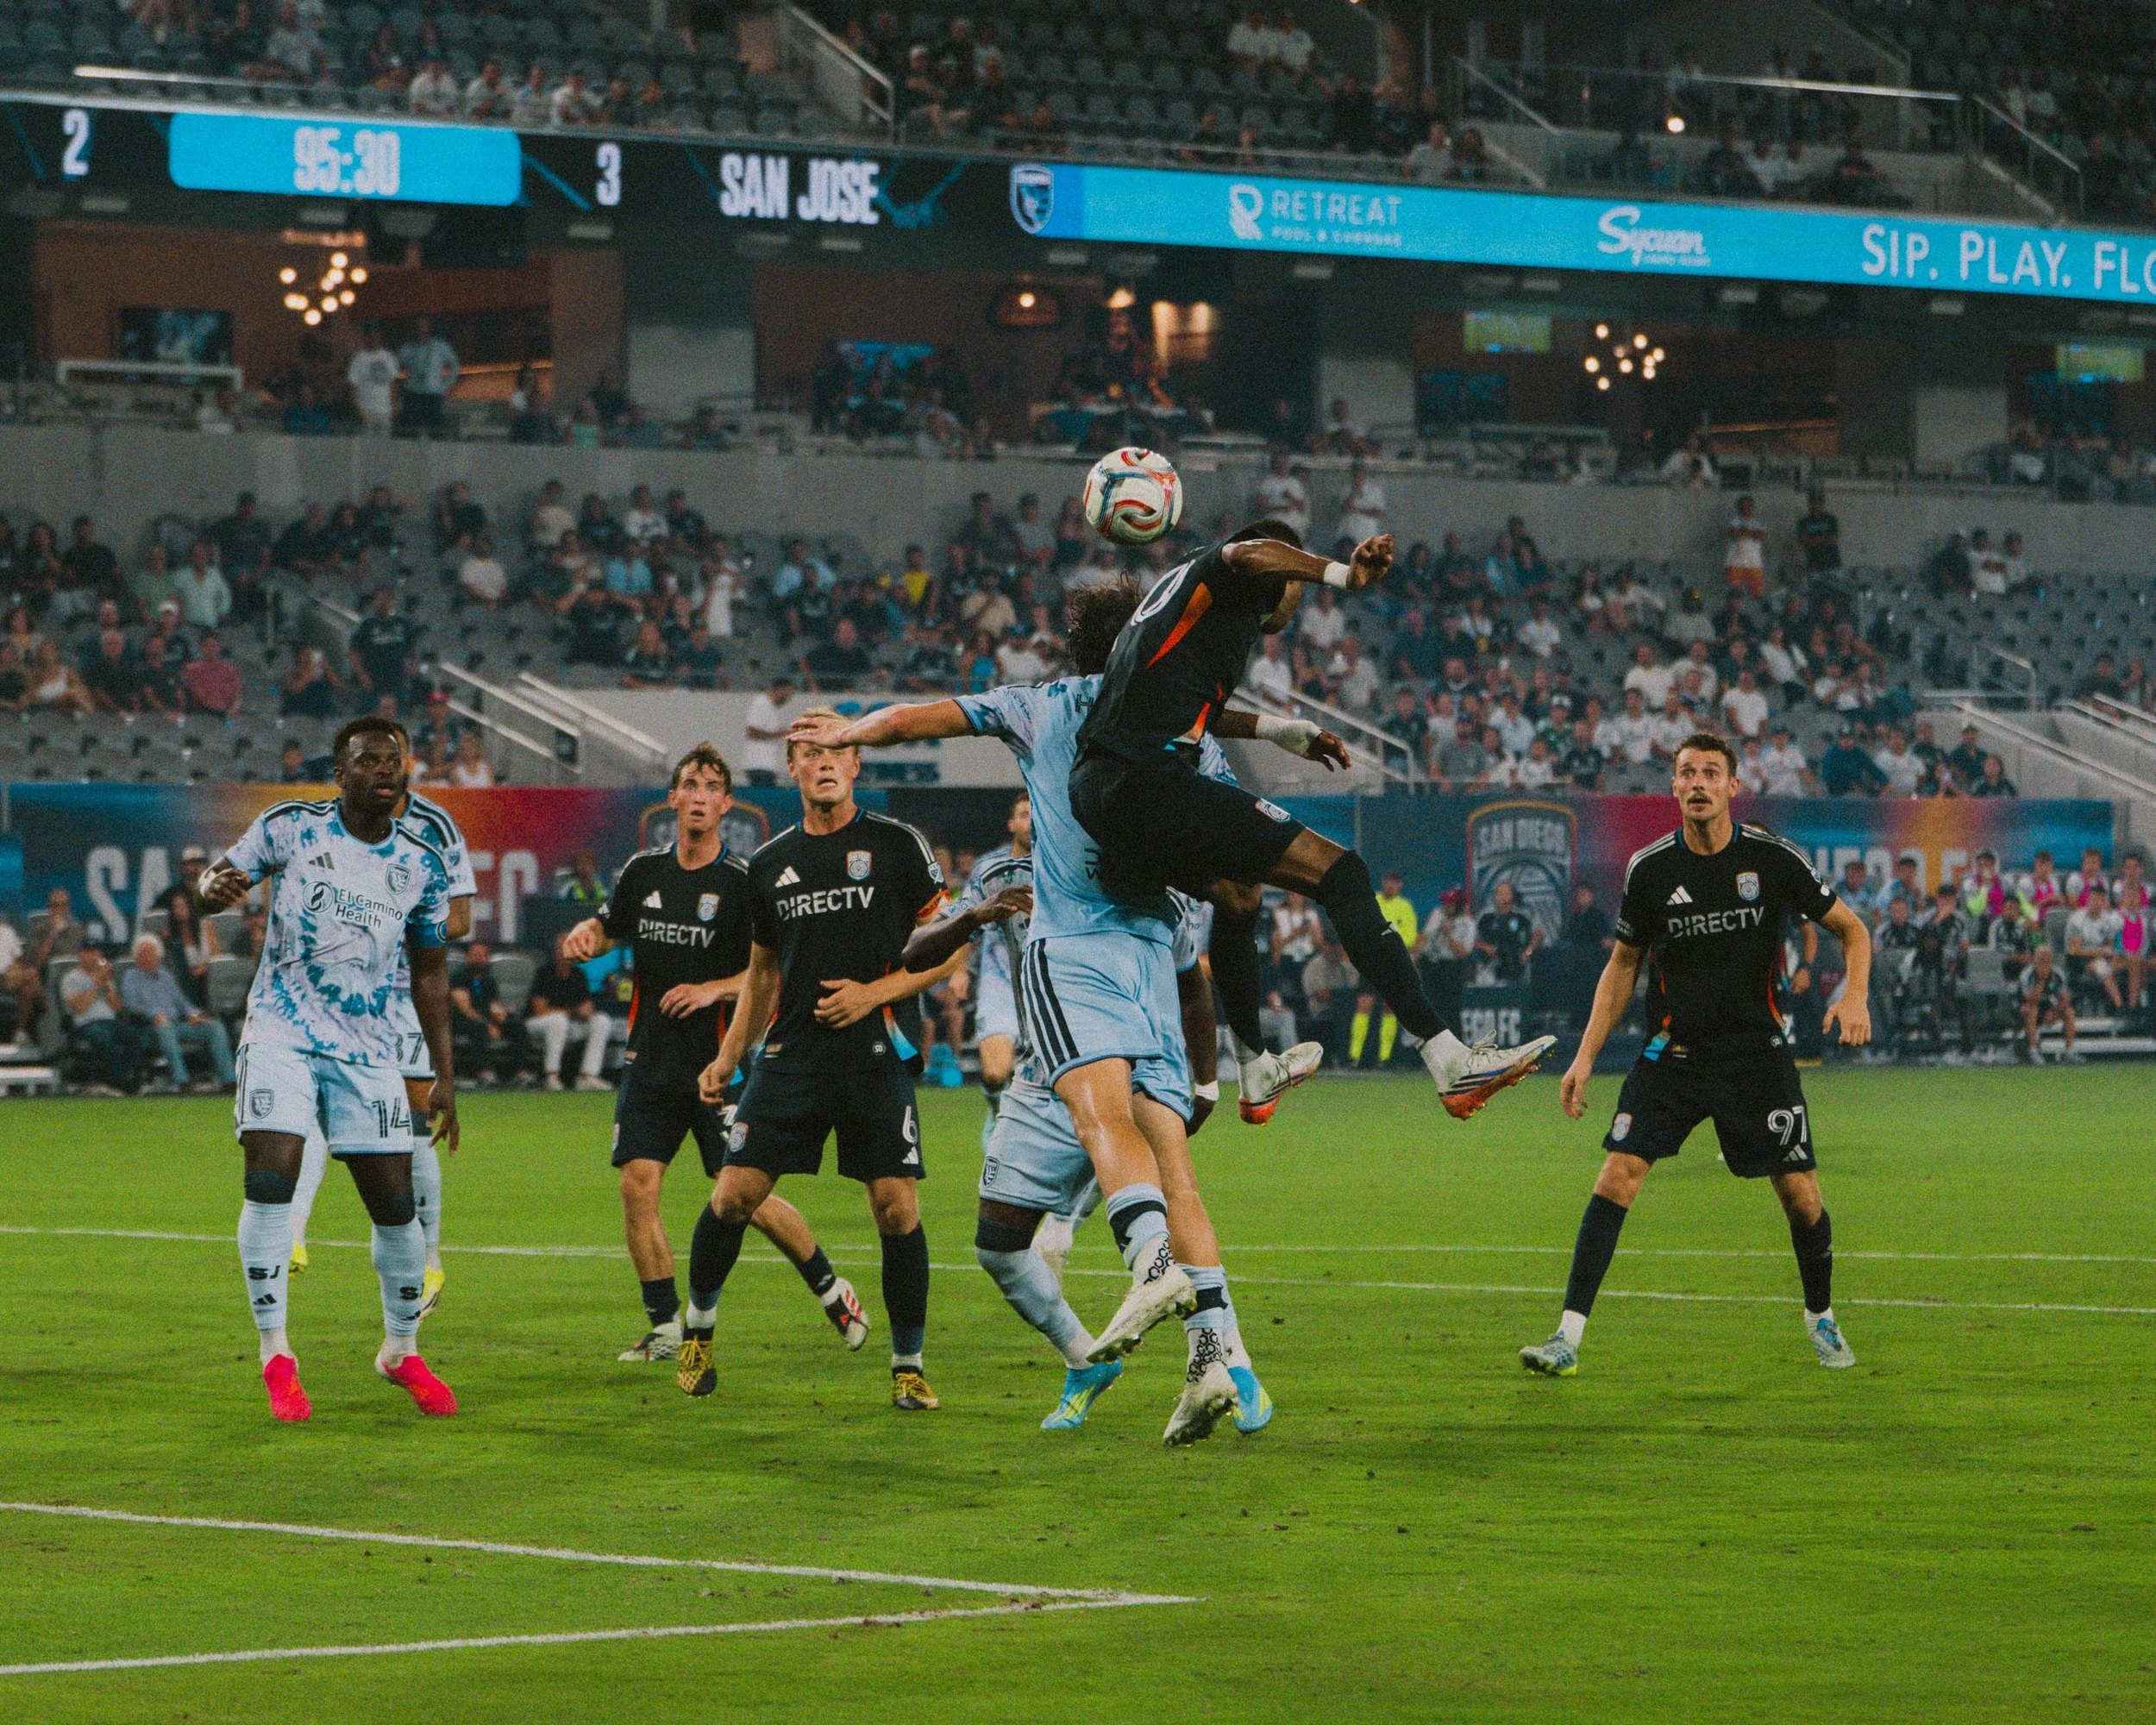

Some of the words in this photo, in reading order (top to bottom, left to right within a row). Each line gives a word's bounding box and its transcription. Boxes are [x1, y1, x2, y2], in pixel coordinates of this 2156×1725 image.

[61, 109, 90, 176] 2
[293, 126, 401, 196] 95:30
[596, 142, 622, 206] 3
[719, 153, 788, 219] SAN
[797, 158, 880, 224] JOSE
[1272, 189, 1402, 226] RETREAT
[1861, 223, 1939, 281] SIP.
[1959, 230, 2072, 288] PLAY.
[87, 845, 172, 944] SA
[337, 888, 352, 903] El
[355, 894, 404, 921] Camino
[776, 886, 874, 922] DIRECTV
[335, 904, 382, 929] Health
[637, 917, 716, 949] DIRECTV
[1667, 906, 1764, 938] DIRECTV
[372, 1097, 411, 1138] 14
[902, 1105, 918, 1145] 6
[1767, 1105, 1808, 1146] 97
[248, 1264, 281, 1281] SJ
